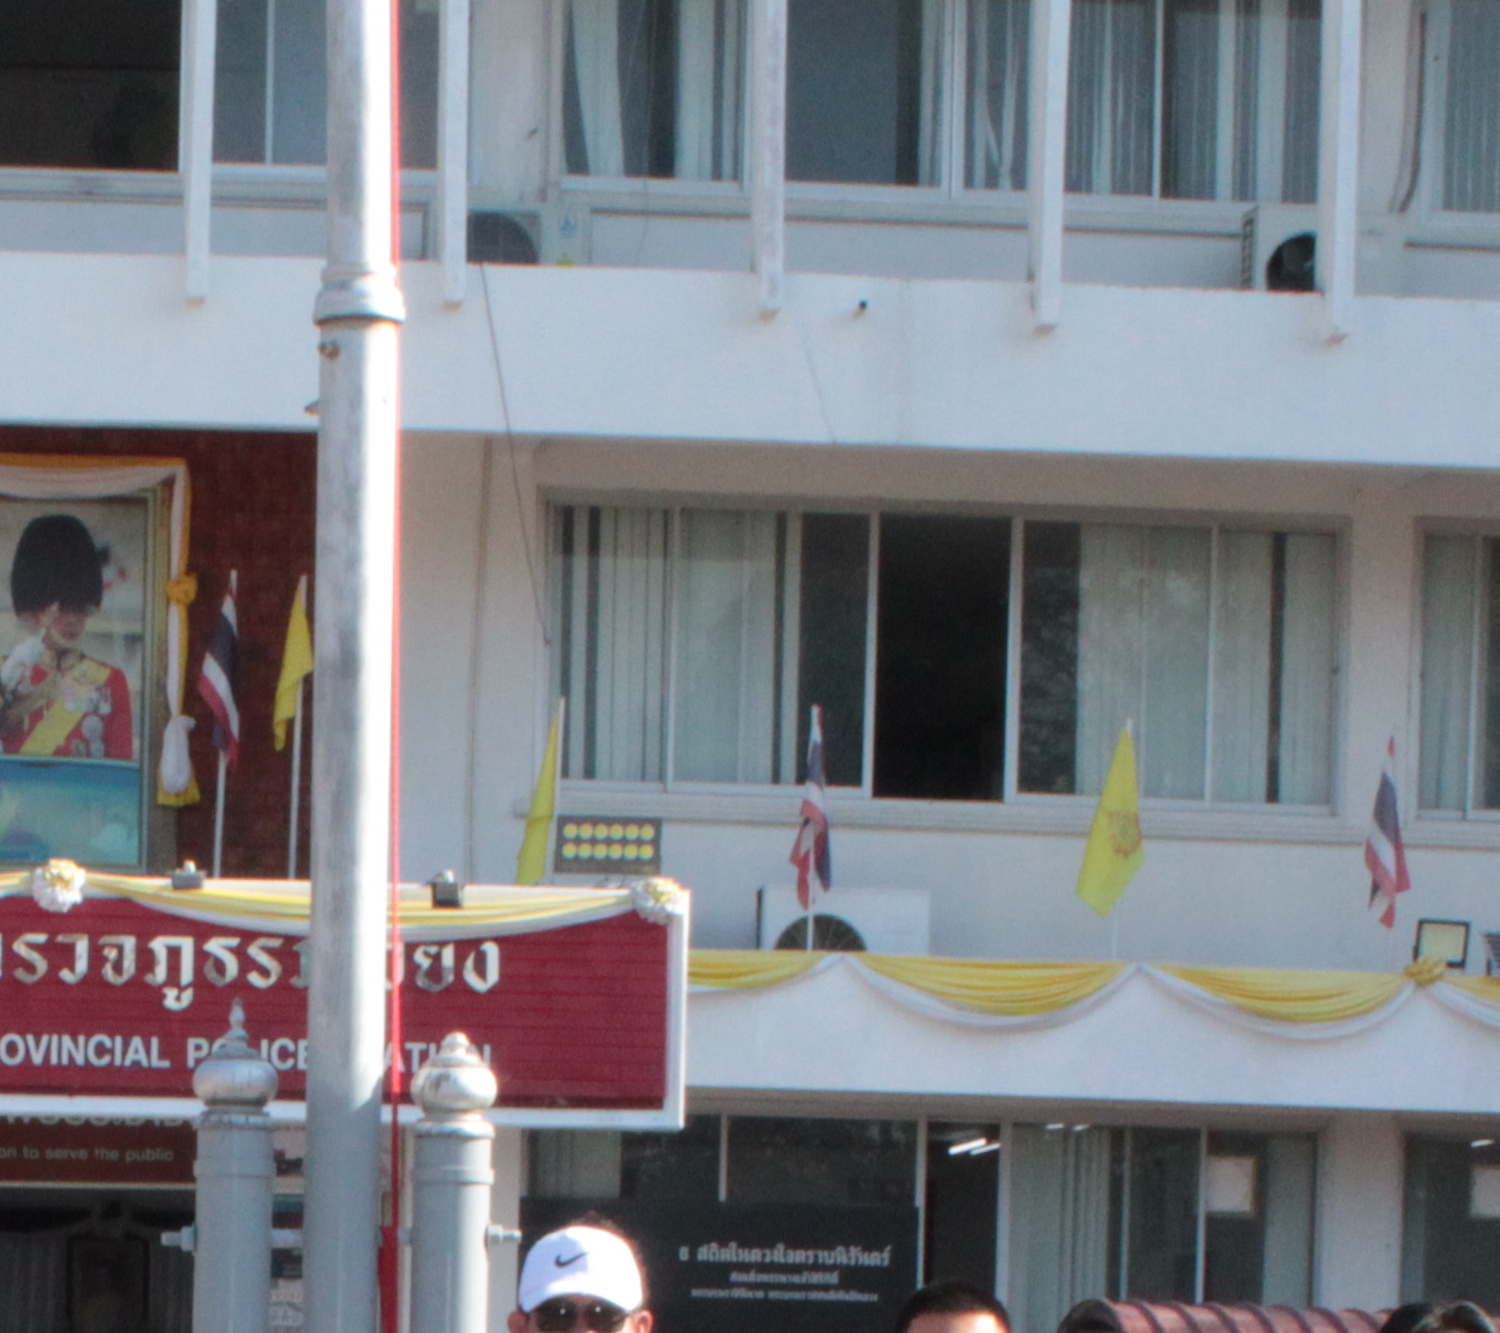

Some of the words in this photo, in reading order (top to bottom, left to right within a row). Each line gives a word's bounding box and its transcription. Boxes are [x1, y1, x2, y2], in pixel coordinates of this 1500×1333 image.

[186, 1036, 309, 1071] PICE
[23, 1145, 40, 1160] to
[45, 1148, 89, 1161] serve
[94, 1146, 119, 1162] the
[125, 1146, 176, 1164] public
